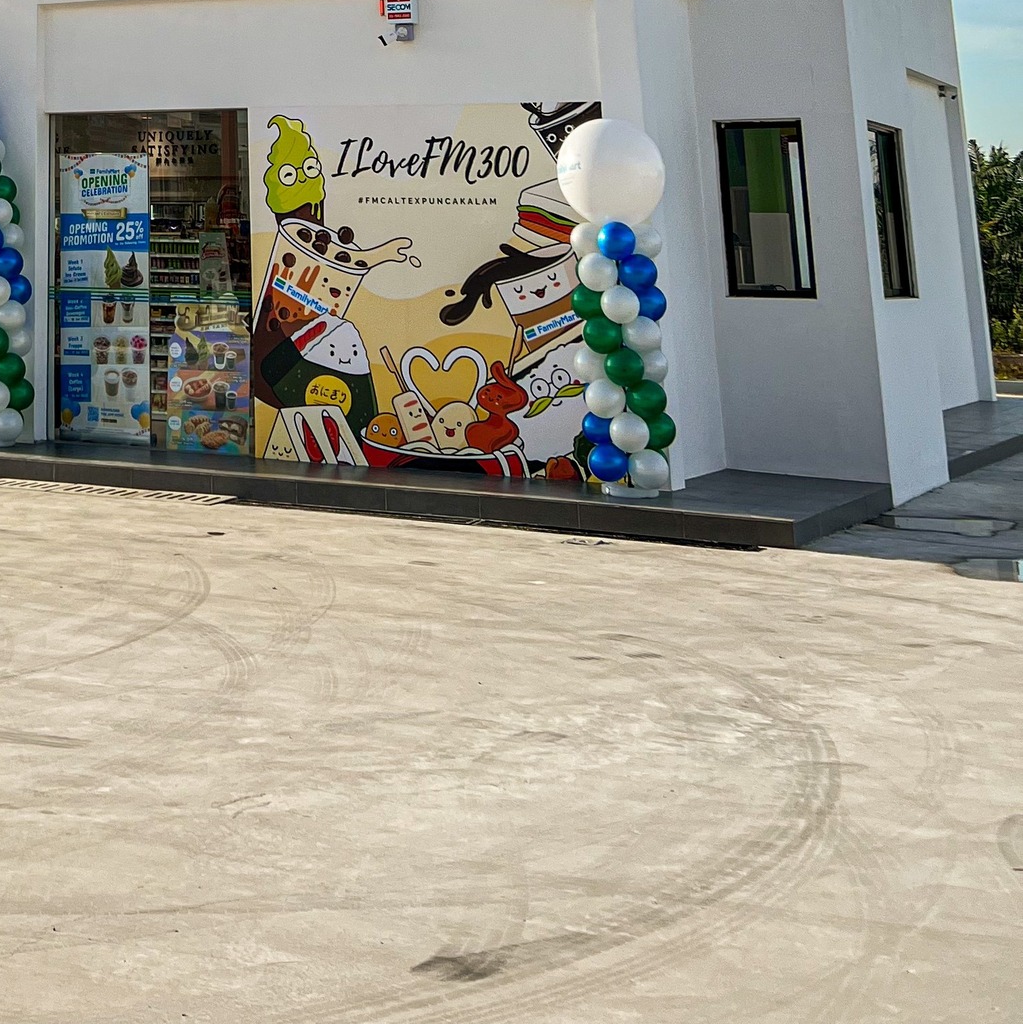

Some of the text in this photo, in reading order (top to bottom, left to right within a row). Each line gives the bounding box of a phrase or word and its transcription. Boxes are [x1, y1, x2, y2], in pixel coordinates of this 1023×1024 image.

[387, 3, 411, 12] SECOM
[138, 130, 214, 145] UNIQUELY
[131, 144, 220, 158] SATISFYING
[81, 173, 128, 189] OPENING
[81, 185, 128, 197] CELEBRATION
[358, 197, 497, 205] #FMCALTEXPUNCAKALAM
[69, 222, 108, 234] OPENING
[116, 221, 144, 241] 25%
[63, 233, 114, 246] PROMOTION
[286, 285, 329, 313] FamilyMart
[310, 383, 347, 403] おにぎり
